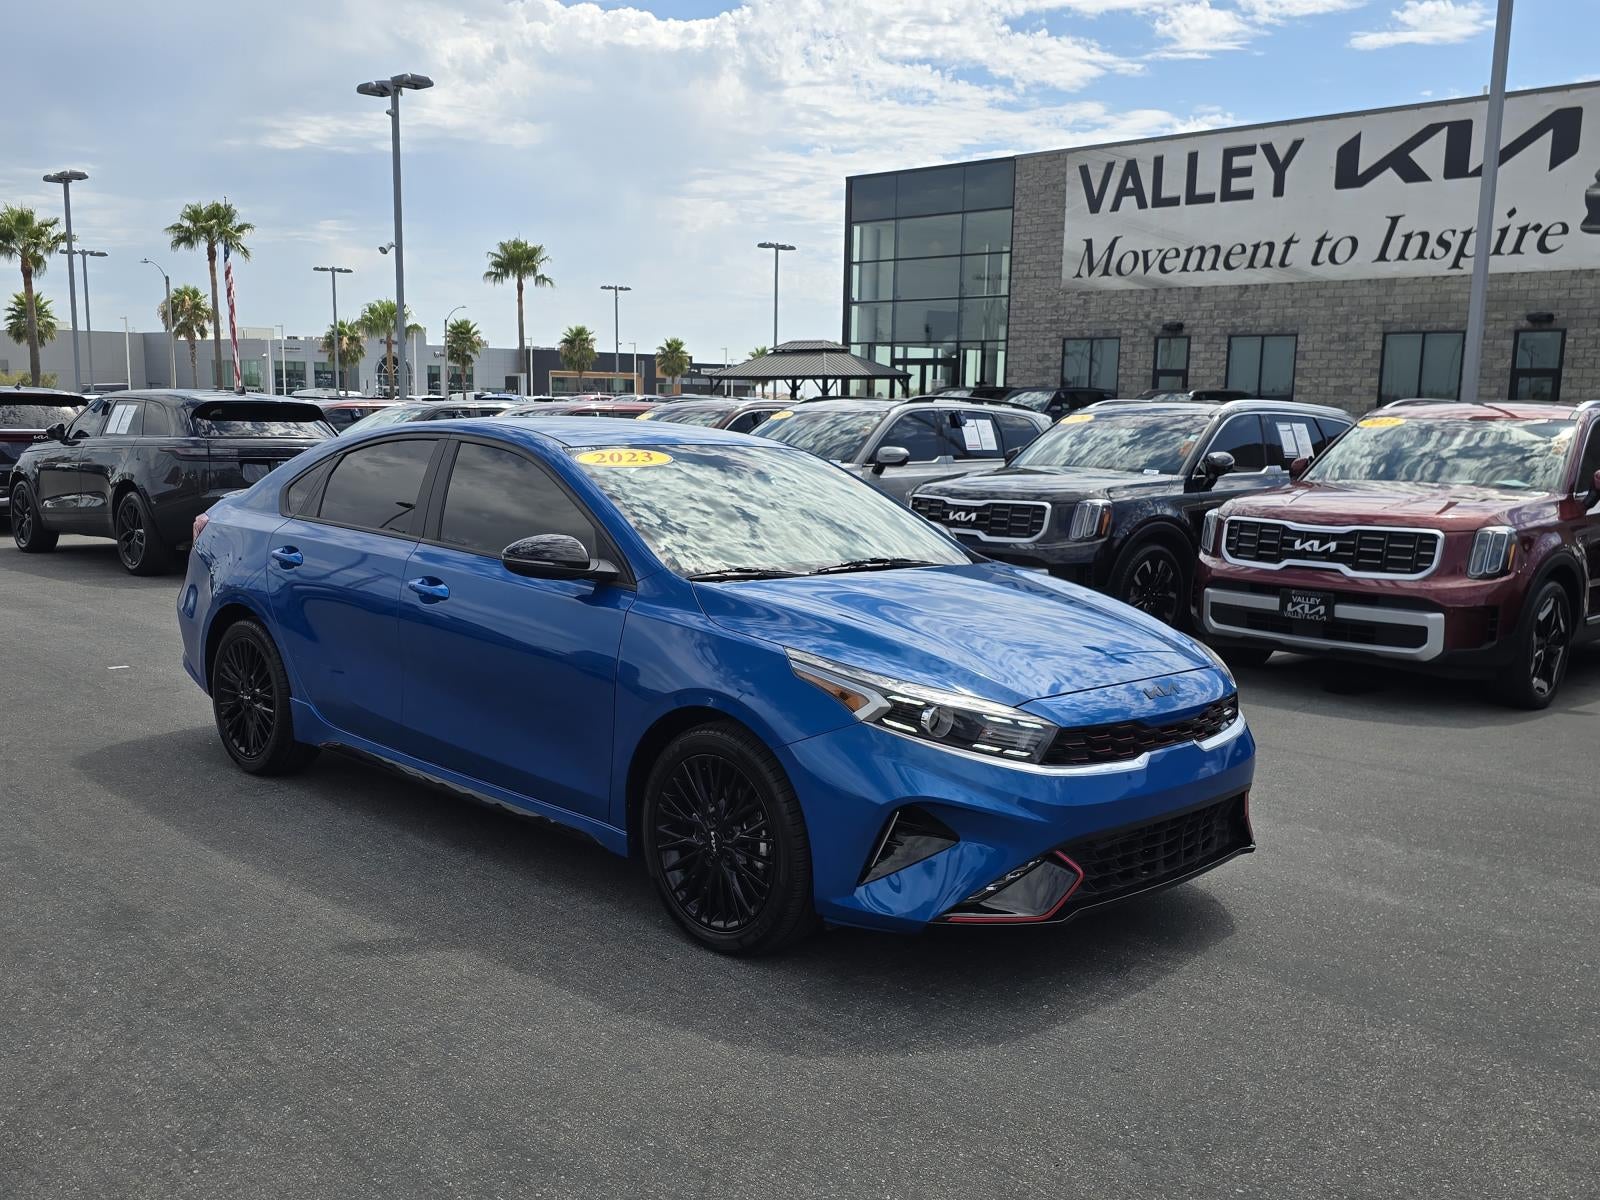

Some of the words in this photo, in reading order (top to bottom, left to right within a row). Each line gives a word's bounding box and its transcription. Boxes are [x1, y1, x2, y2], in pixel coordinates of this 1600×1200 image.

[1078, 137, 1305, 214] VALLEY
[1334, 106, 1584, 190] KIA
[1072, 231, 1301, 279] Movement
[1311, 229, 1359, 267] to
[1371, 206, 1570, 271] Inspire
[593, 451, 653, 463] 2023
[949, 510, 977, 522] KIA
[1294, 538, 1337, 553] KIA
[1291, 595, 1321, 605] VALLEY
[1287, 602, 1325, 615] KIA
[1143, 682, 1180, 700] KIA
